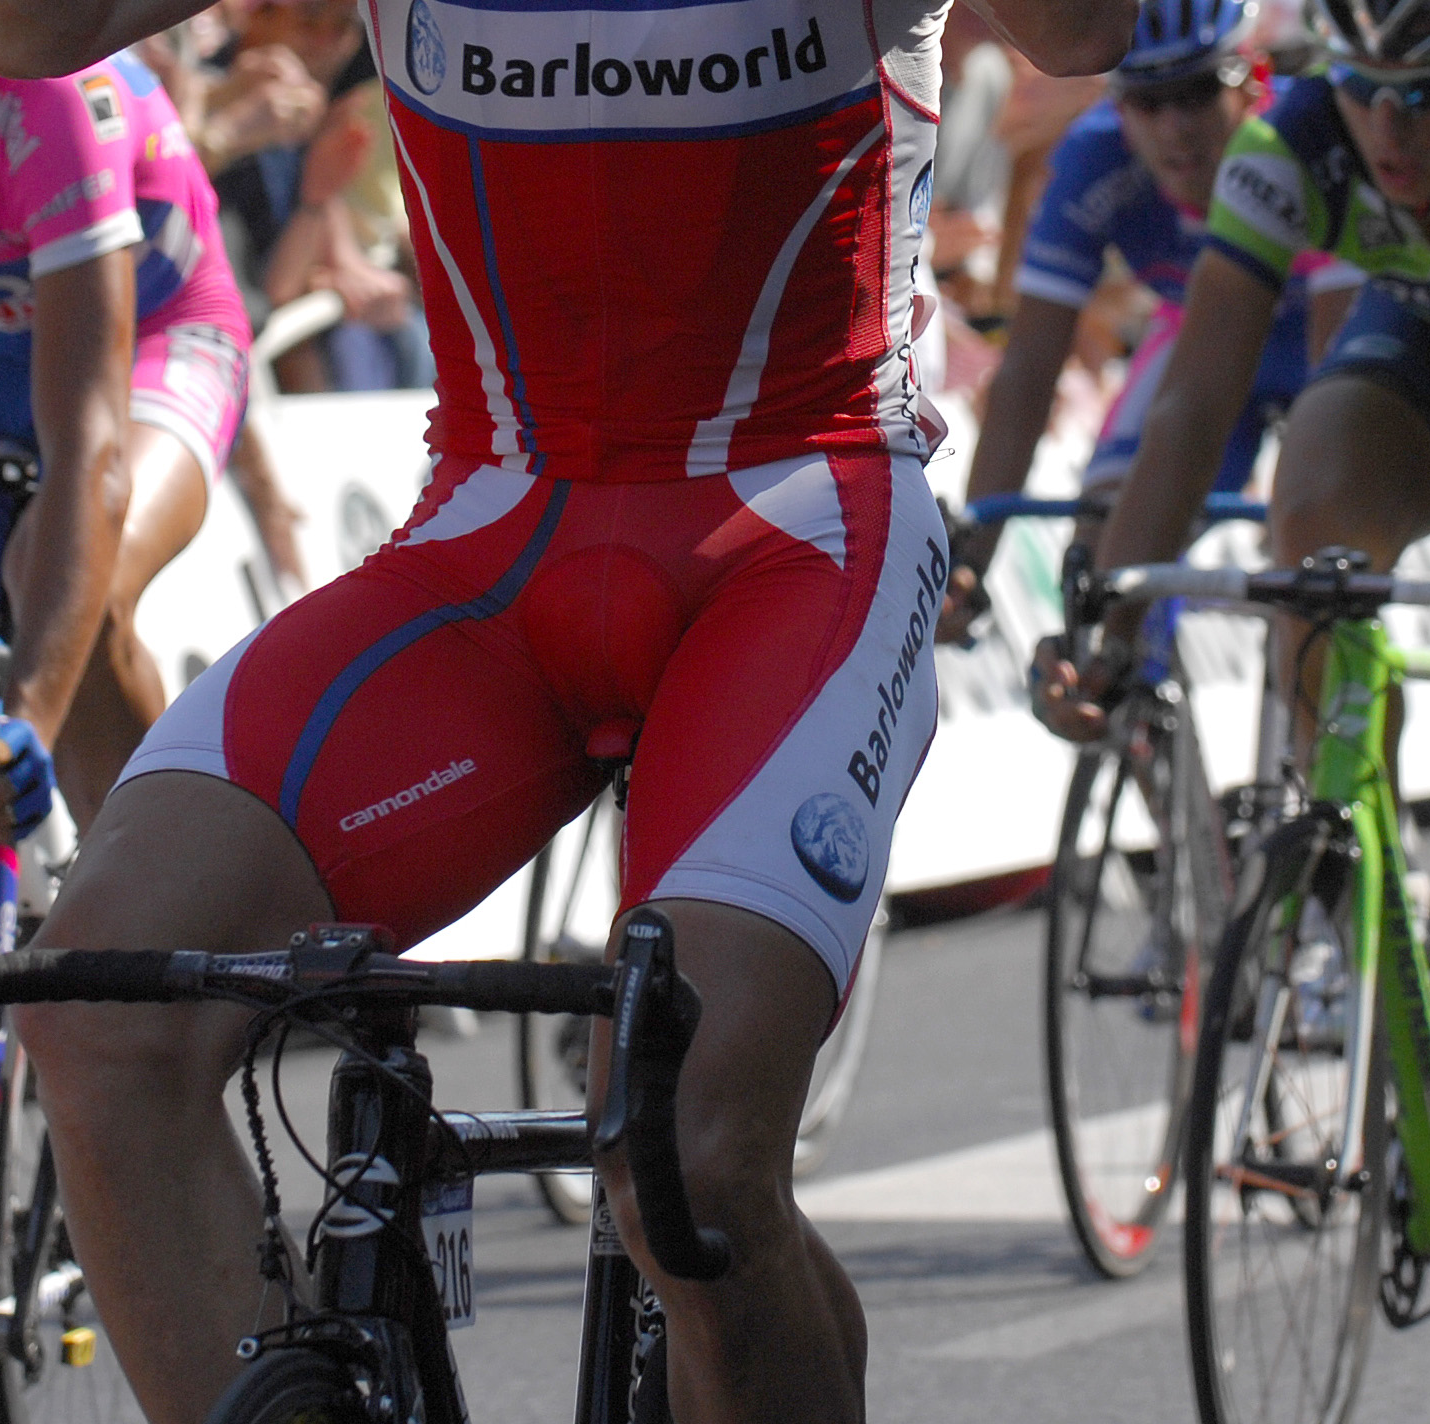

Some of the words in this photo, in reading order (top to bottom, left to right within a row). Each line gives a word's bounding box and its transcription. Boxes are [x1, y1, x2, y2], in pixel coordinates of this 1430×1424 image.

[461, 15, 828, 99] Barloworld
[846, 536, 948, 810] Barloworld
[338, 757, 478, 833] cannondale
